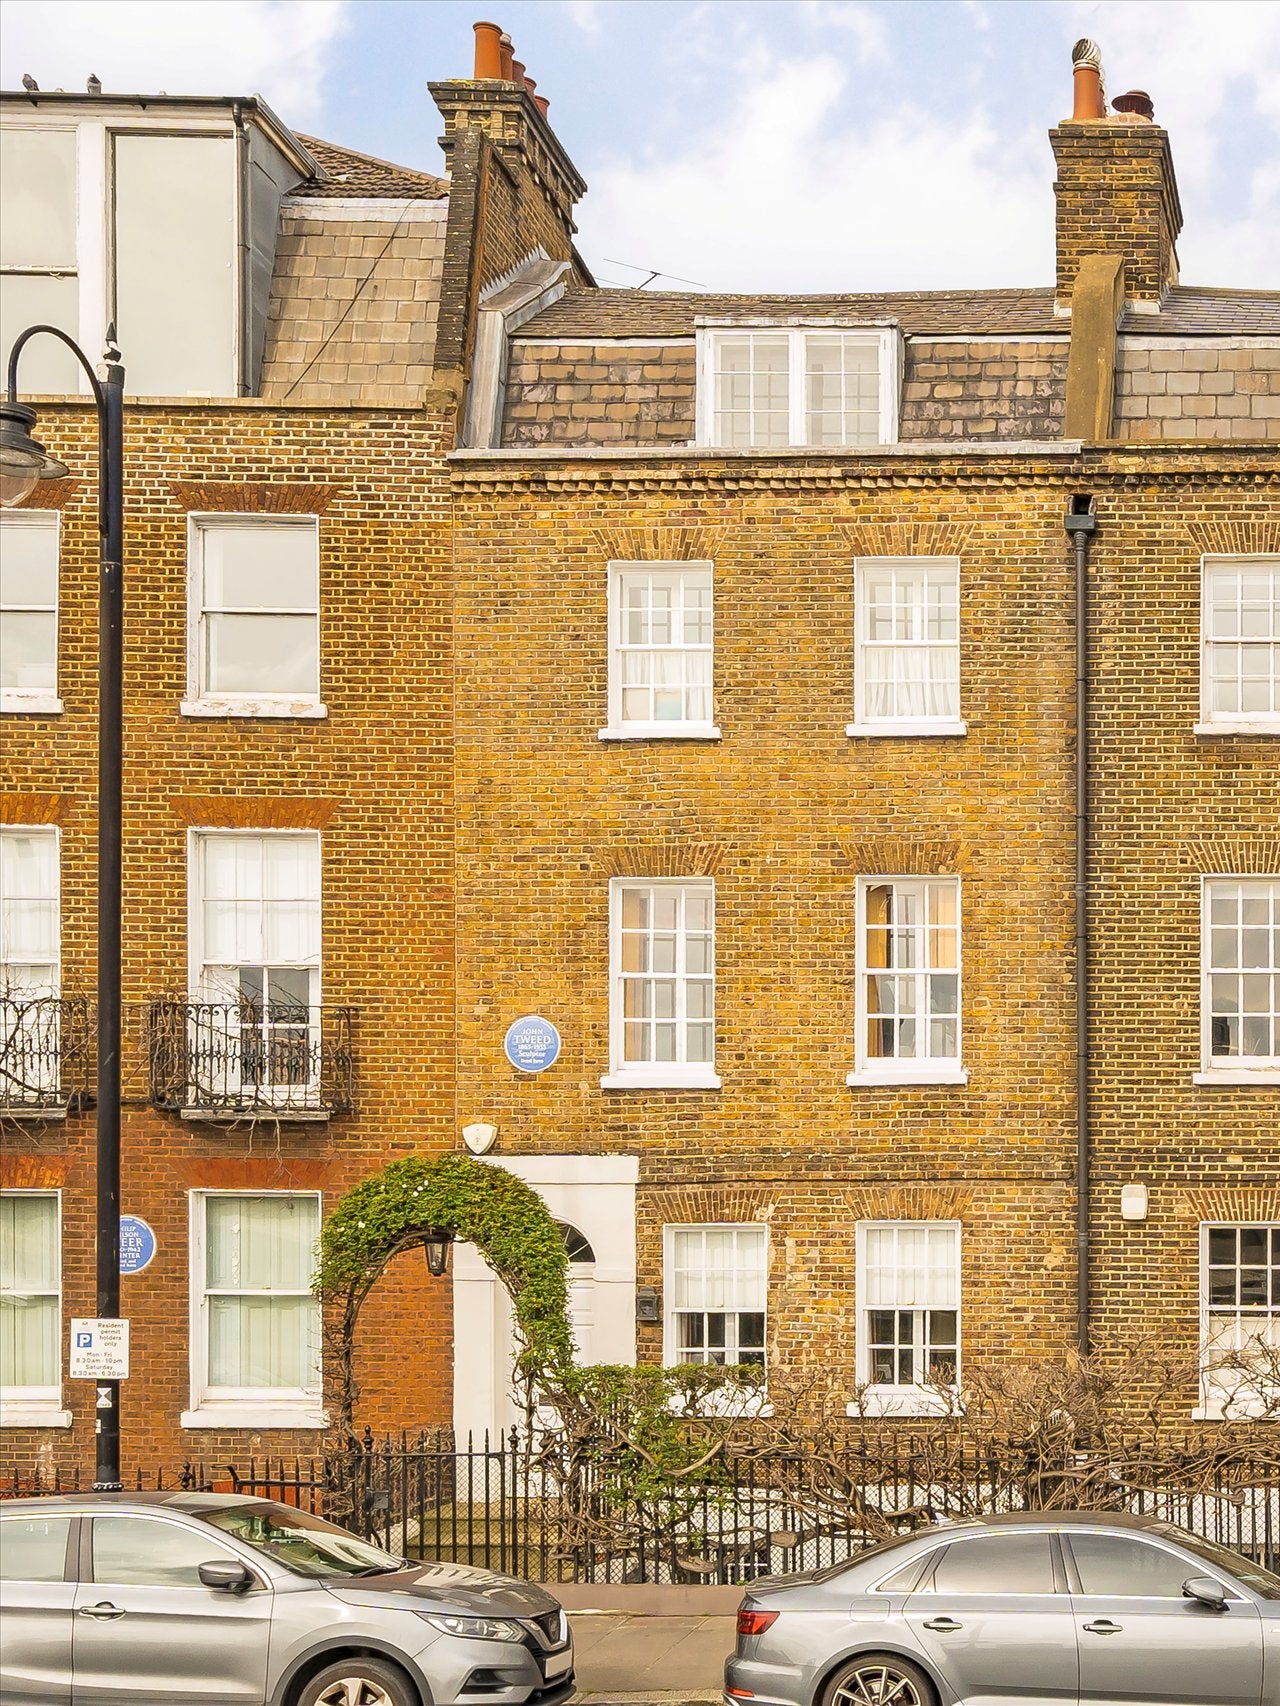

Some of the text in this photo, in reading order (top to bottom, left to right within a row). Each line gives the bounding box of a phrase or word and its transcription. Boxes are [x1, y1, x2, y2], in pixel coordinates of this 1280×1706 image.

[513, 1035, 551, 1044] TWEED
[121, 1237, 144, 1247] EER
[79, 1334, 91, 1347] P
